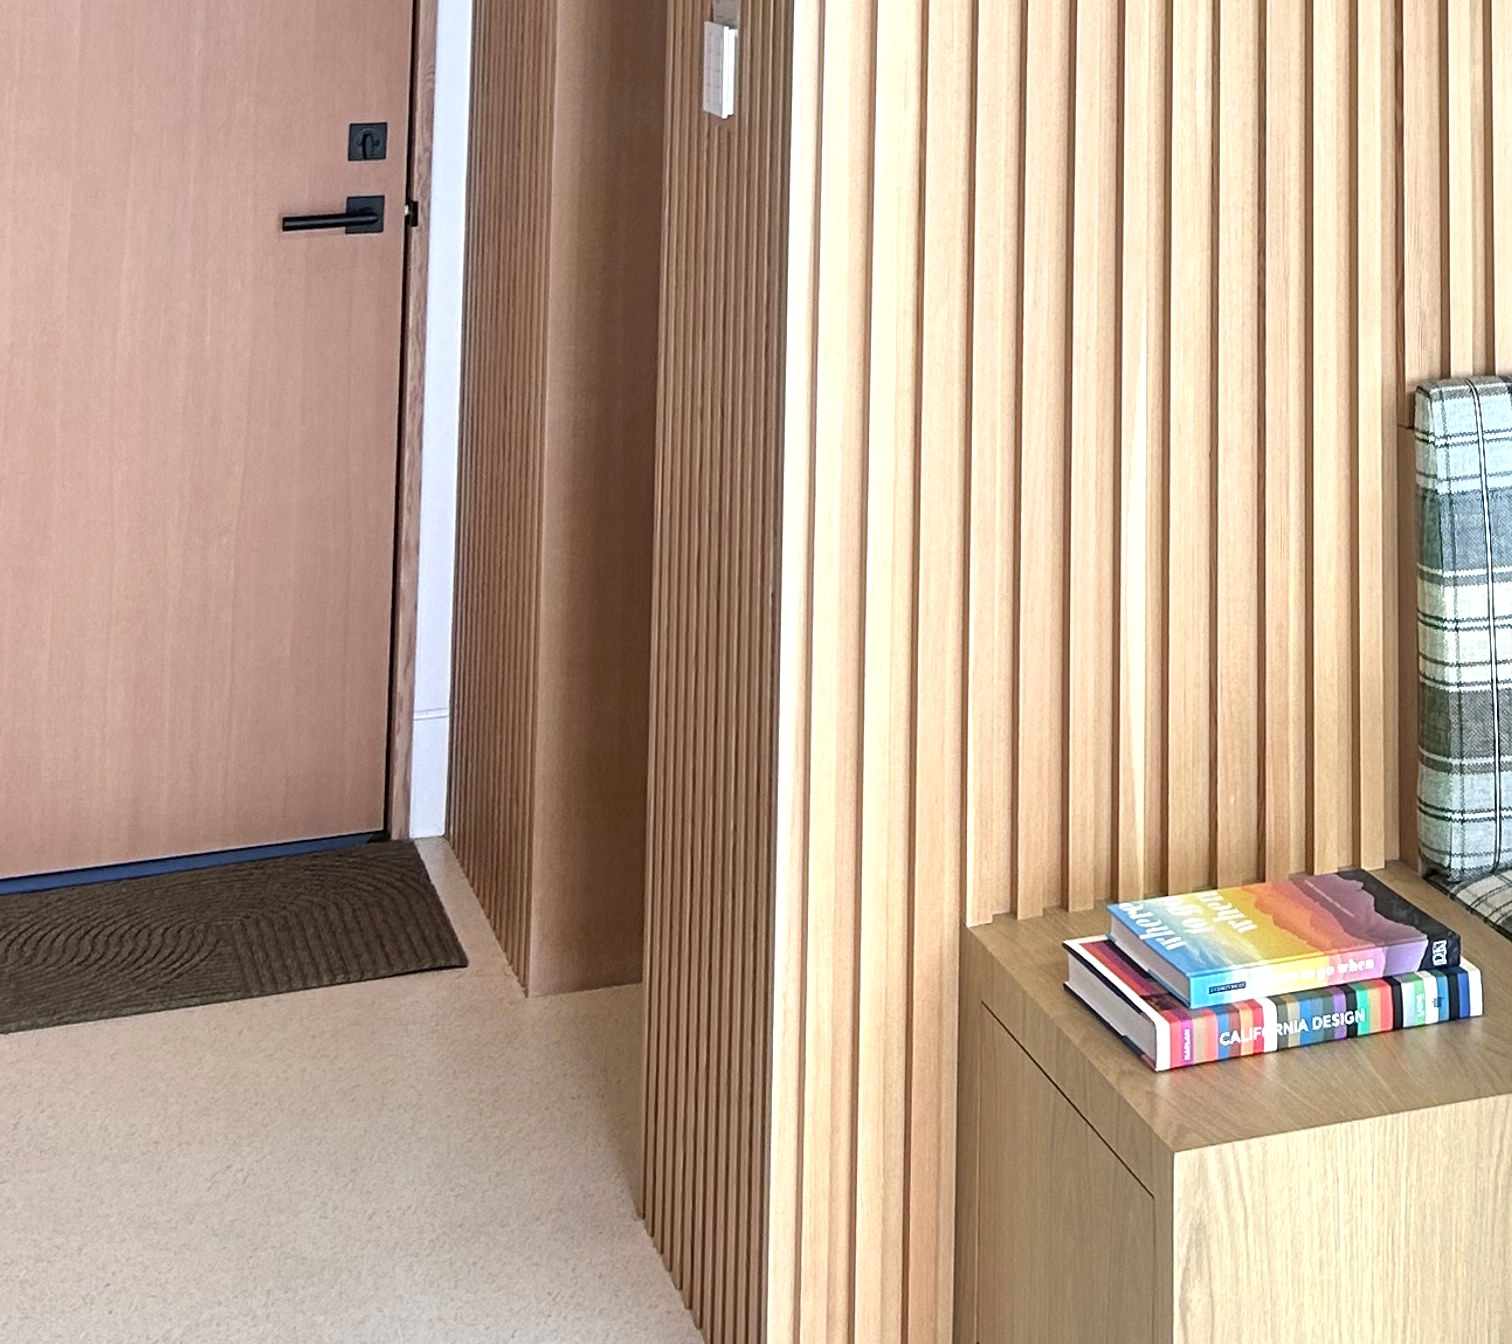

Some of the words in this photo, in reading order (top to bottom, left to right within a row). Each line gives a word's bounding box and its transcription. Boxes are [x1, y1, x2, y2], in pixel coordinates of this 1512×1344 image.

[1338, 957, 1375, 975] when
[1219, 1016, 1309, 1047] CALIFRNIA
[1312, 1008, 1366, 1031] DESIGN
